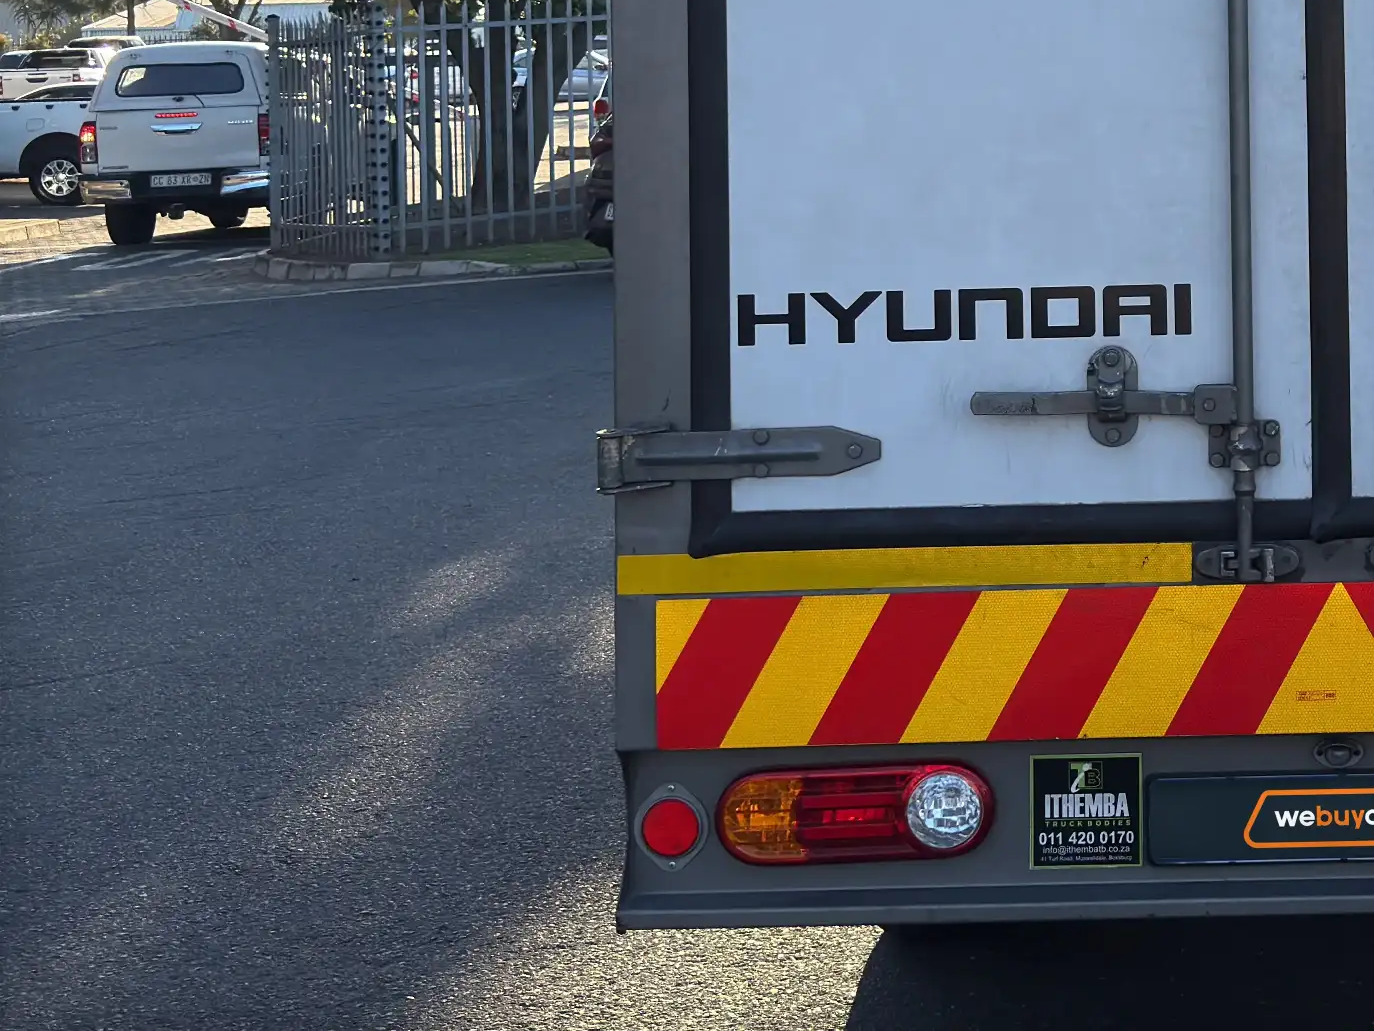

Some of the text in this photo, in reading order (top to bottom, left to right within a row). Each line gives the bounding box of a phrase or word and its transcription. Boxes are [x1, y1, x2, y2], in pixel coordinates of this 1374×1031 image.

[737, 283, 1192, 346] HYUNDAI
[1044, 792, 1130, 818] ITHEMBA
[1044, 819, 1131, 828] TRUCK BODIES
[1038, 830, 1135, 845] 011 420 0170
[1042, 845, 1130, 856] info@ithembatb.co.za
